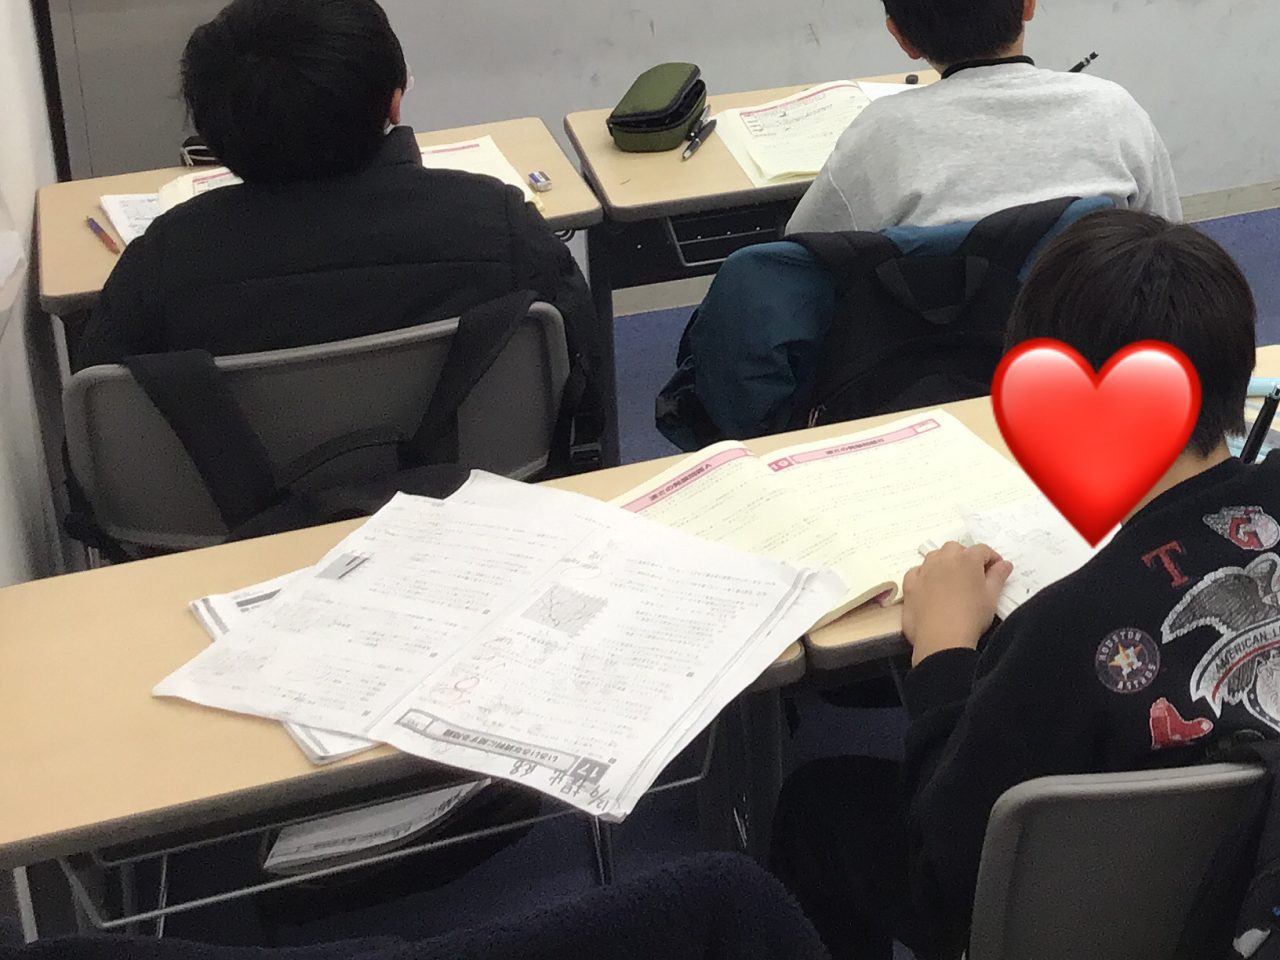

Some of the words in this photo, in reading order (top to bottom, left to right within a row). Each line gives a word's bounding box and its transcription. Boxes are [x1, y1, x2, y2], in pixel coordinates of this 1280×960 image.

[1140, 540, 1190, 589] T
[1098, 631, 1143, 662] HOUSTON
[1213, 632, 1268, 675] AMERICAN
